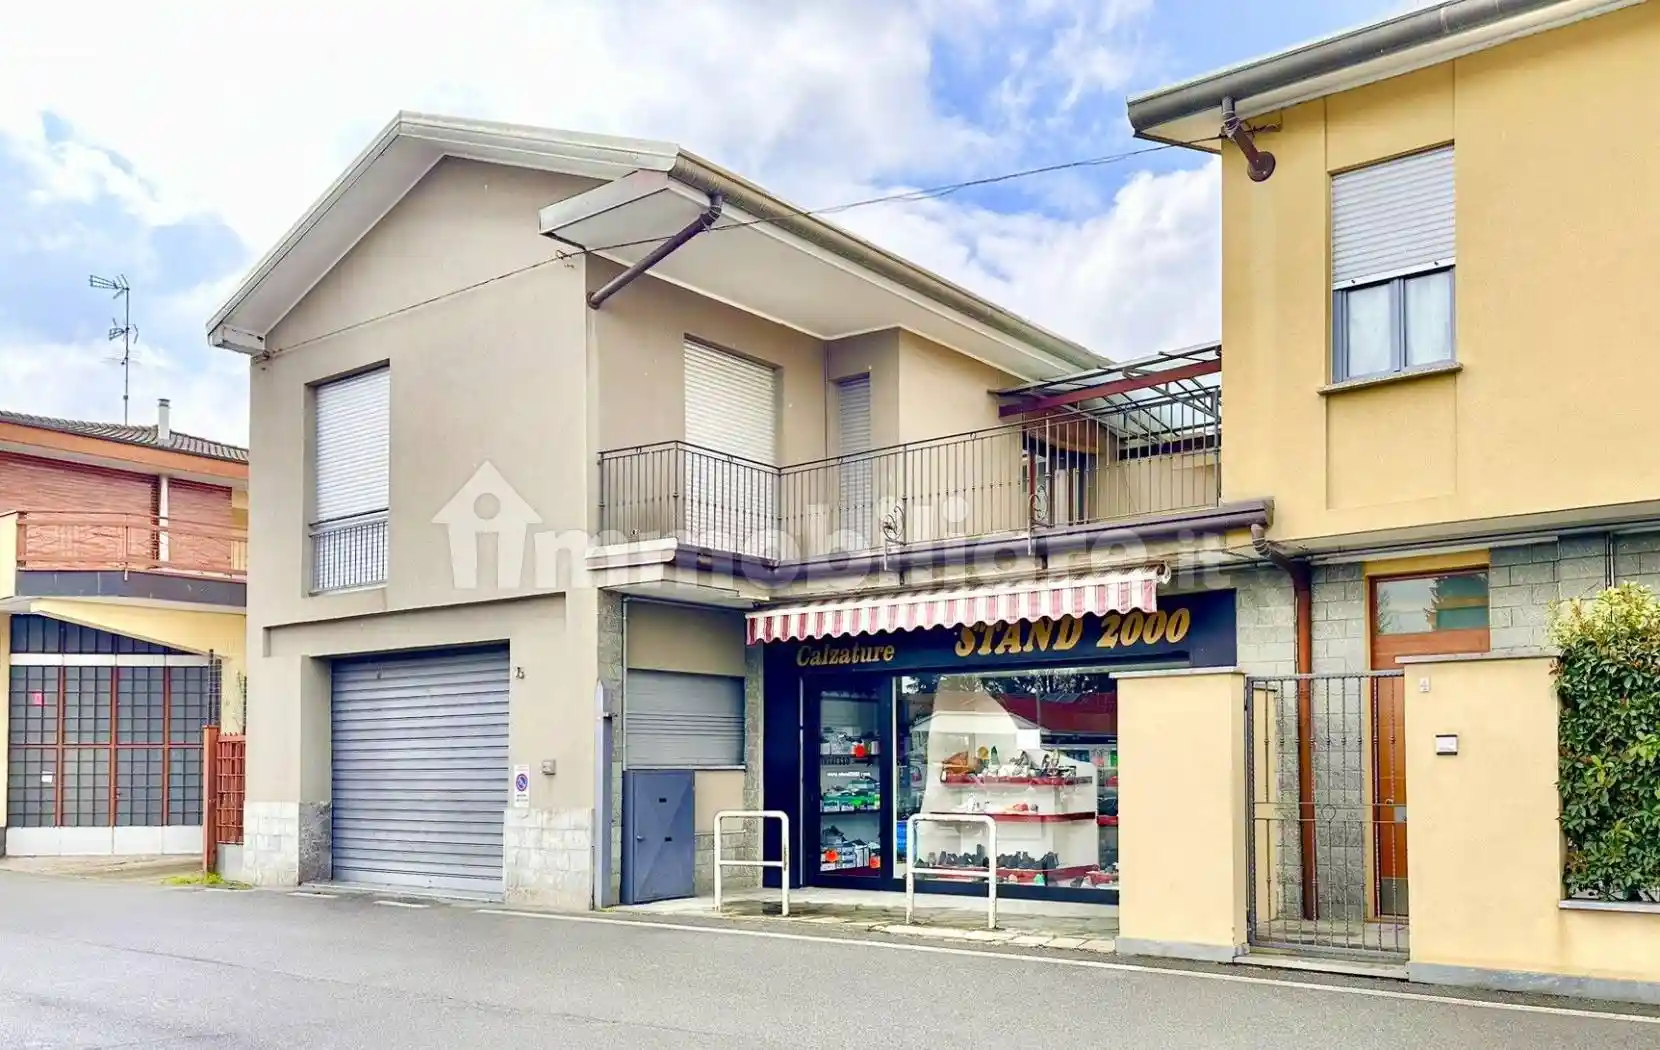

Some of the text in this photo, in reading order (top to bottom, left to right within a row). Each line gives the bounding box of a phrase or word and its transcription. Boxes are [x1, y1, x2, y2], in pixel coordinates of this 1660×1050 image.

[955, 607, 1191, 657] STAND 2000
[796, 644, 895, 667] Calzature
